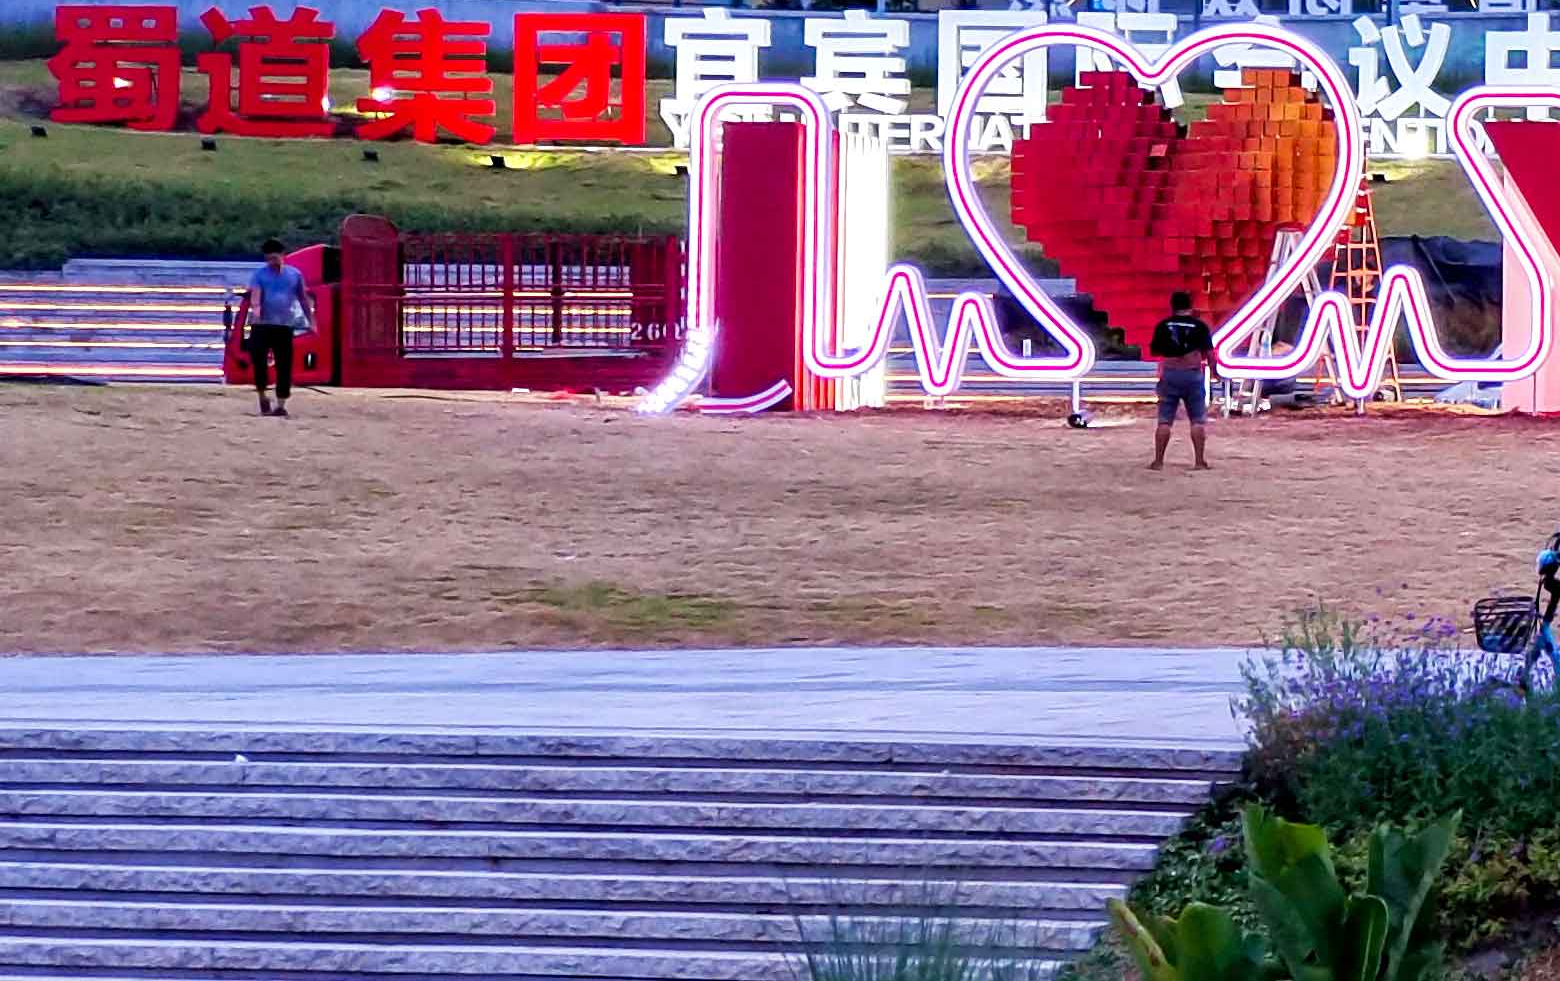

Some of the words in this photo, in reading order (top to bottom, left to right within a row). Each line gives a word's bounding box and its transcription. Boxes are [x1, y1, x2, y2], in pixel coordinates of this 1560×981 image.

[48, 5, 646, 145] 蜀道集团
[712, 118, 840, 411] I
